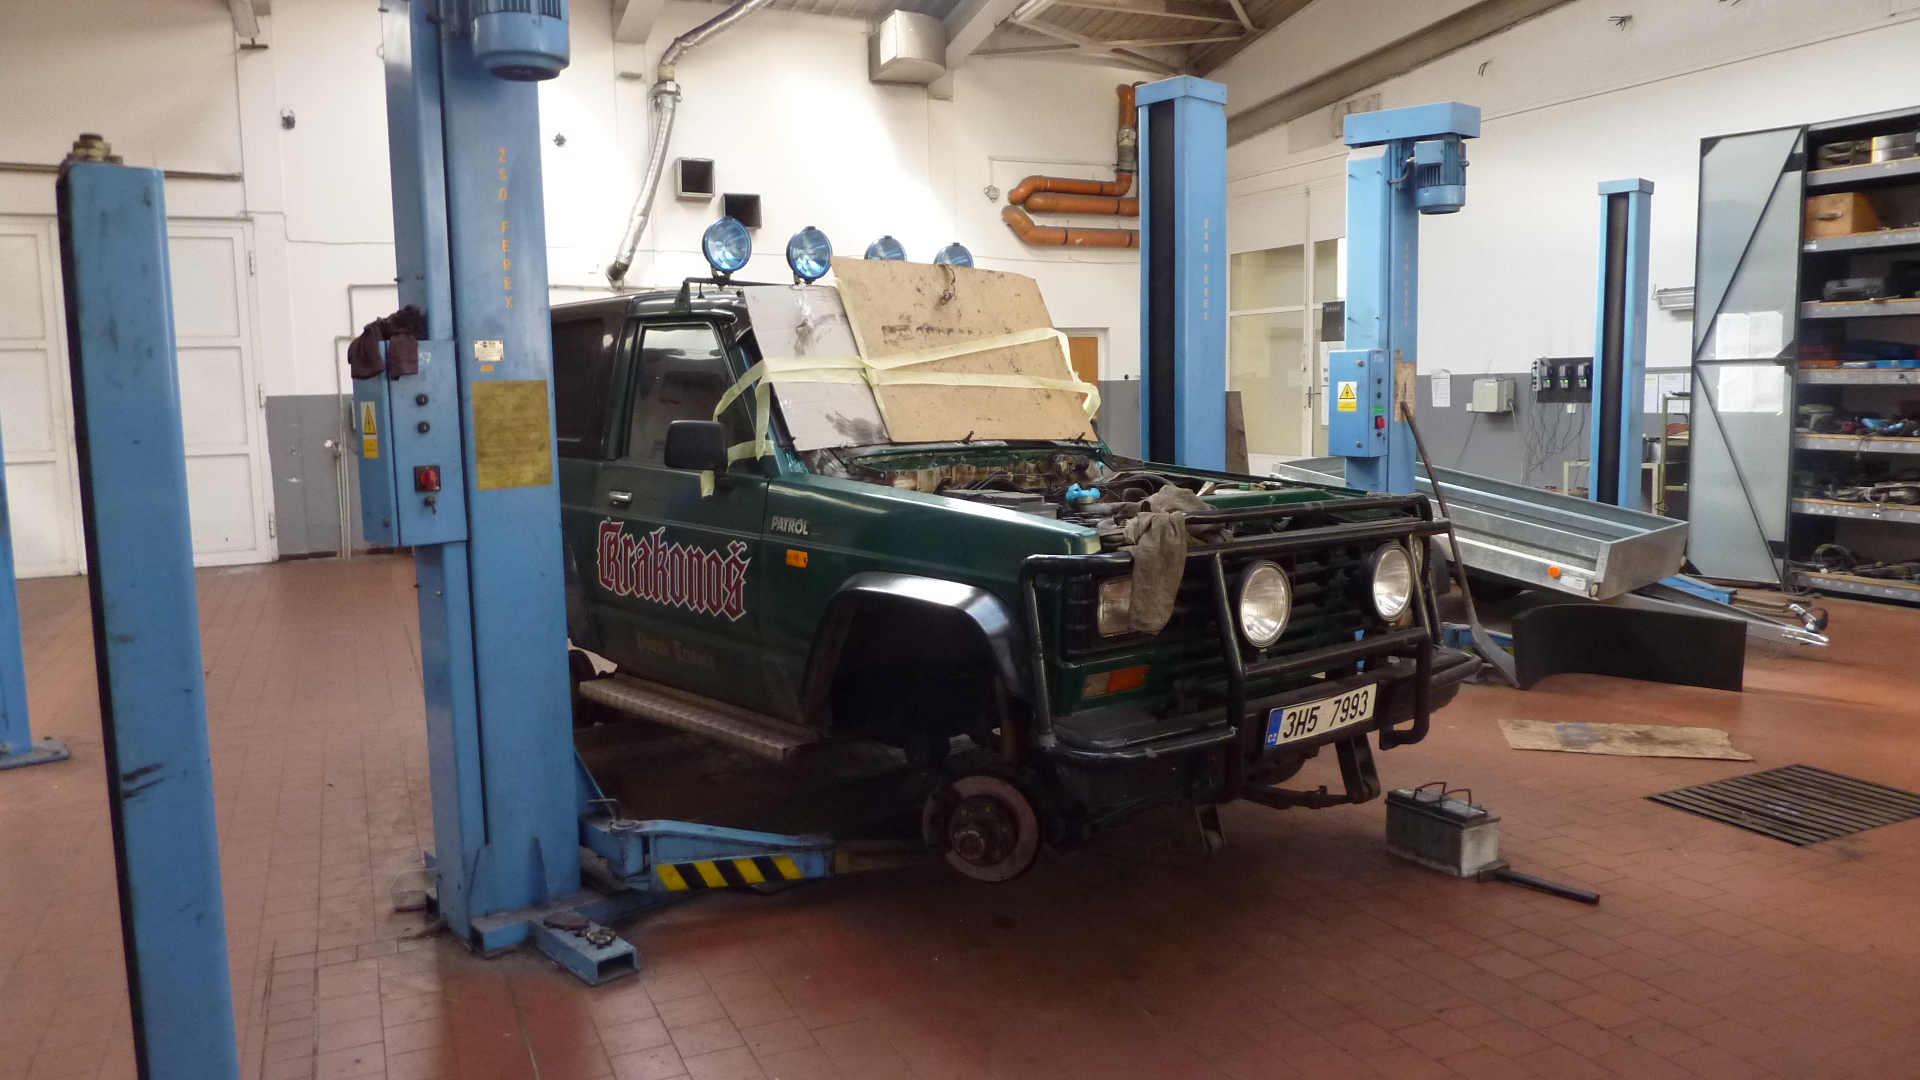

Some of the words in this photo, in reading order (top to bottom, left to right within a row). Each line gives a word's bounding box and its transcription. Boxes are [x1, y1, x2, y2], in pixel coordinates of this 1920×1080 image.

[501, 220, 513, 308] FEREX
[771, 515, 810, 536] PATROL
[597, 516, 751, 622] Krakonoš
[1267, 733, 1278, 743] CZ
[1283, 704, 1322, 739] 3H5
[1329, 689, 1369, 727] 7993
